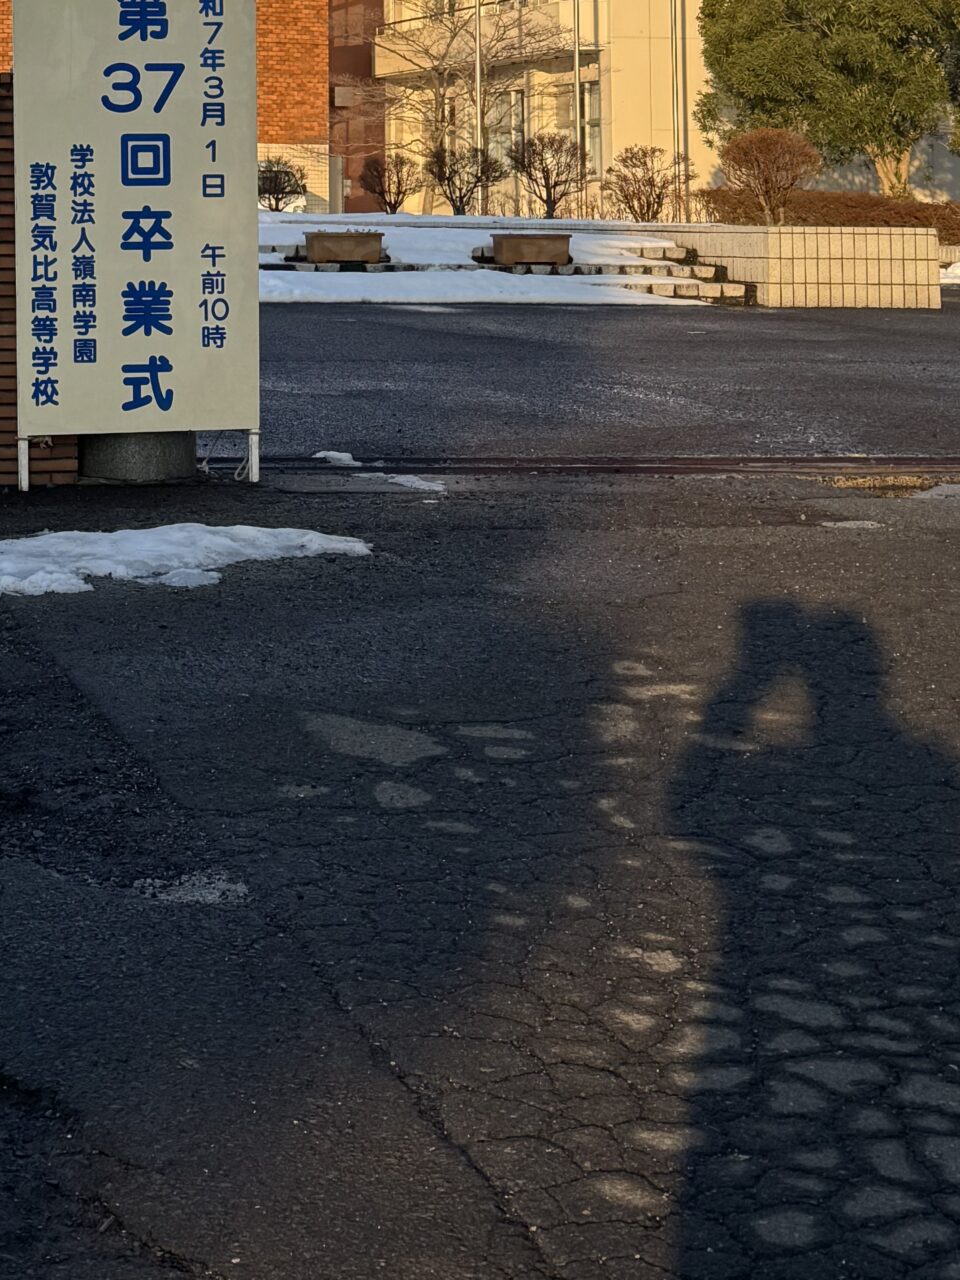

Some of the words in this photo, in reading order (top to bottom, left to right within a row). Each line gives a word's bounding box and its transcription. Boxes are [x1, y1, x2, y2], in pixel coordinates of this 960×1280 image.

[29, 162, 60, 407] 敦賀気比高等学校
[69, 143, 97, 364] 学校法人嶺南学園
[198, 243, 229, 349] 午前10時
